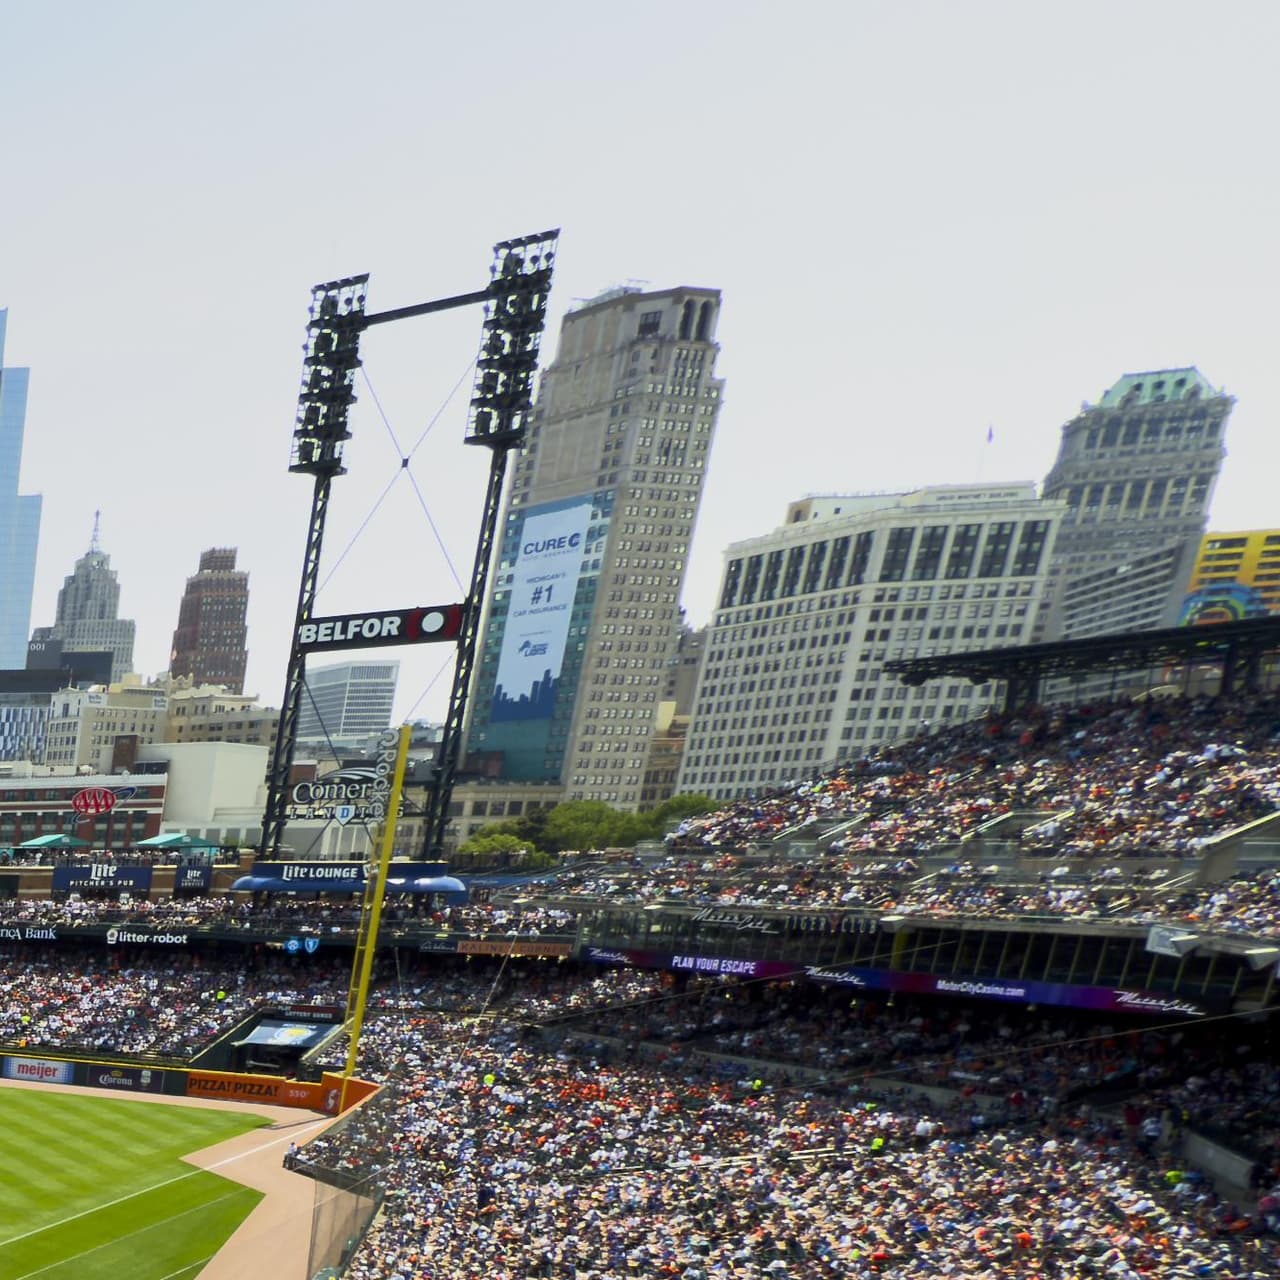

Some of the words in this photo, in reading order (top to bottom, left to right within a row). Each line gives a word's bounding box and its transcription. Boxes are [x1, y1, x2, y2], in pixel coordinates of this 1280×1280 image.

[524, 535, 568, 555] CURE
[531, 584, 554, 605] #1
[513, 610, 527, 618] CAR
[528, 604, 568, 615] INSURANCE
[299, 616, 401, 643] BELFOR
[310, 867, 358, 878] LOUNGE
[70, 879, 114, 887] PITCHER'S
[117, 879, 134, 887] PUB
[25, 926, 57, 939] Bank
[672, 955, 694, 969] PLAN
[696, 957, 719, 971] YOUR
[720, 959, 757, 974] ESCAPE
[937, 979, 1025, 997] MotorCityCasino.com
[17, 1061, 59, 1079] meijer
[190, 1078, 232, 1093] PIZZA!
[234, 1082, 279, 1097] PIZZA!
